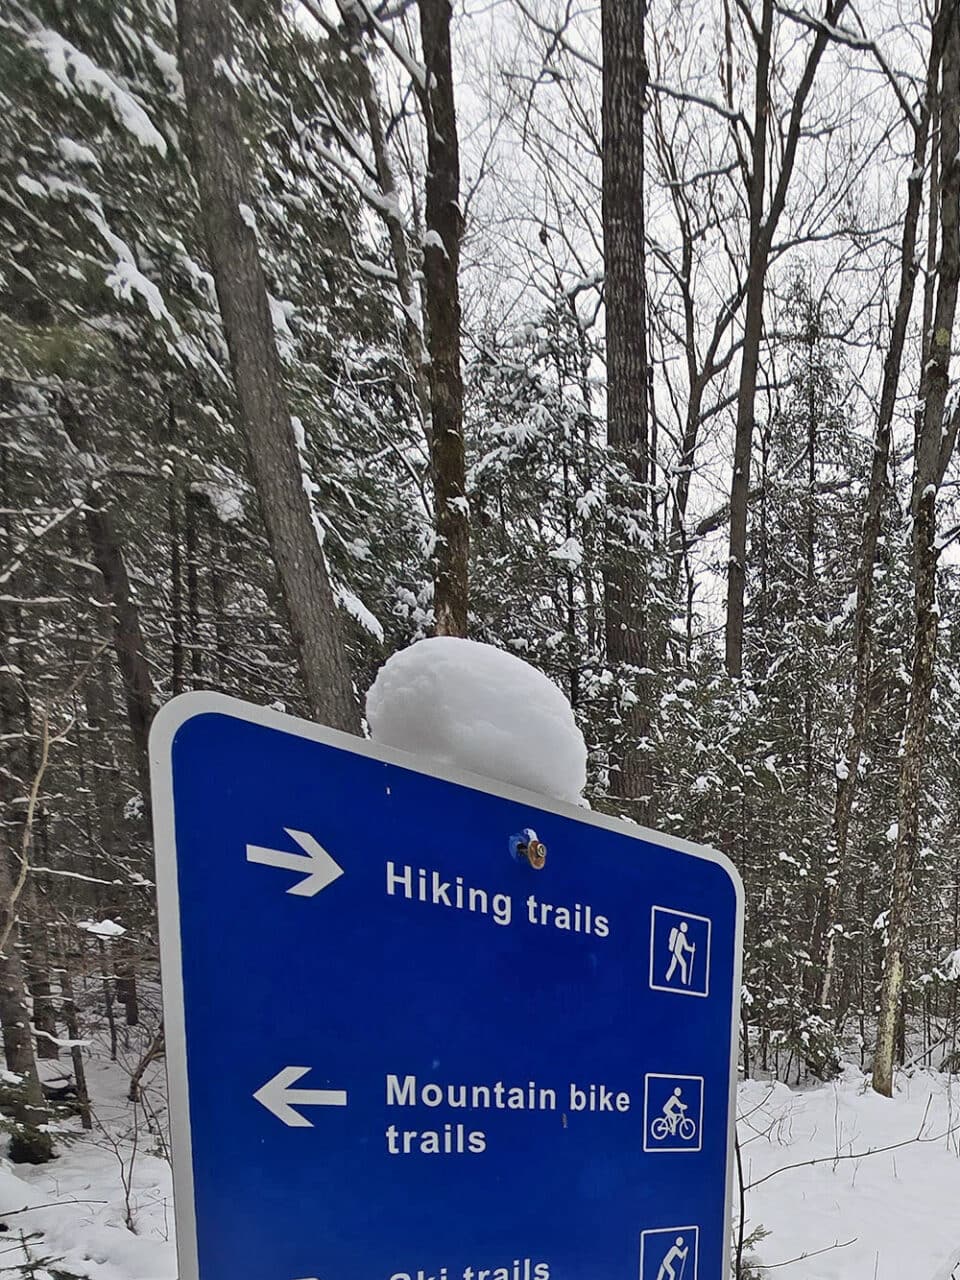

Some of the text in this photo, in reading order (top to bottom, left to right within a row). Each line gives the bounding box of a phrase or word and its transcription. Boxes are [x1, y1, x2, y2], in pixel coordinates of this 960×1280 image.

[387, 862, 609, 936] Hiking trails
[387, 1075, 629, 1111] Mountain bike
[386, 1124, 485, 1153] trails
